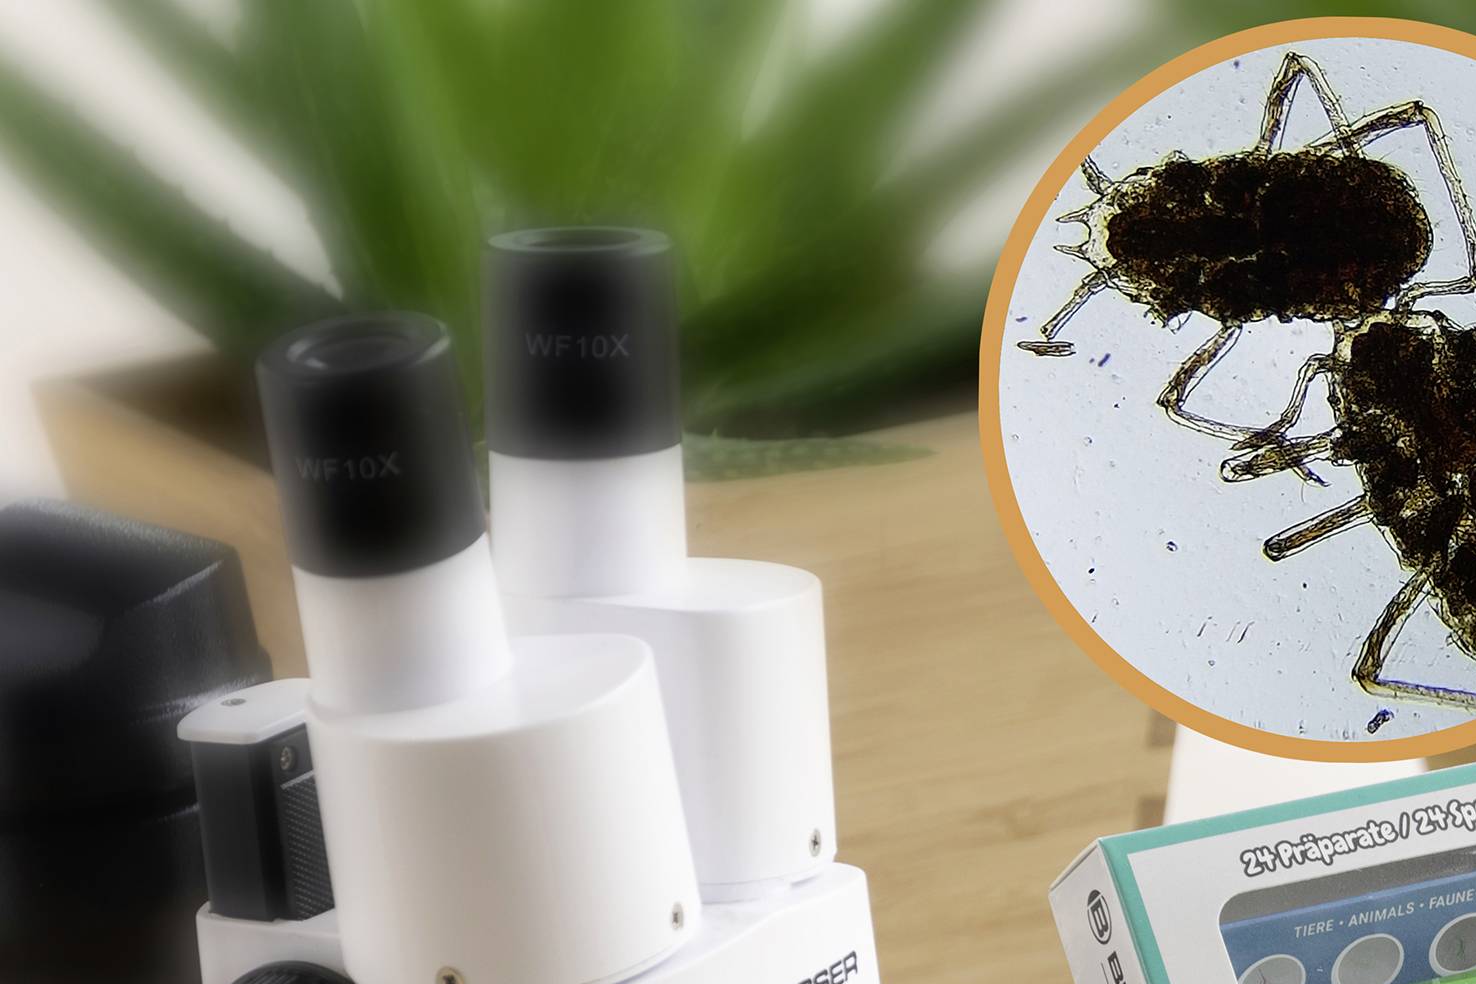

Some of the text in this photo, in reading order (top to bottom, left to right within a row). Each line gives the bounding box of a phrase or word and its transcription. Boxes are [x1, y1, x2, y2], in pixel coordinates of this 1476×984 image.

[526, 333, 629, 358] WF10X
[295, 451, 401, 482] WF10X
[1240, 846, 1278, 877] 24
[1275, 821, 1399, 872] Präparate
[1399, 812, 1411, 839] /
[1413, 807, 1448, 834] 24
[1294, 919, 1334, 939] TIERE
[1347, 902, 1415, 927] ANIMALS
[1429, 890, 1475, 910] FAUNE
